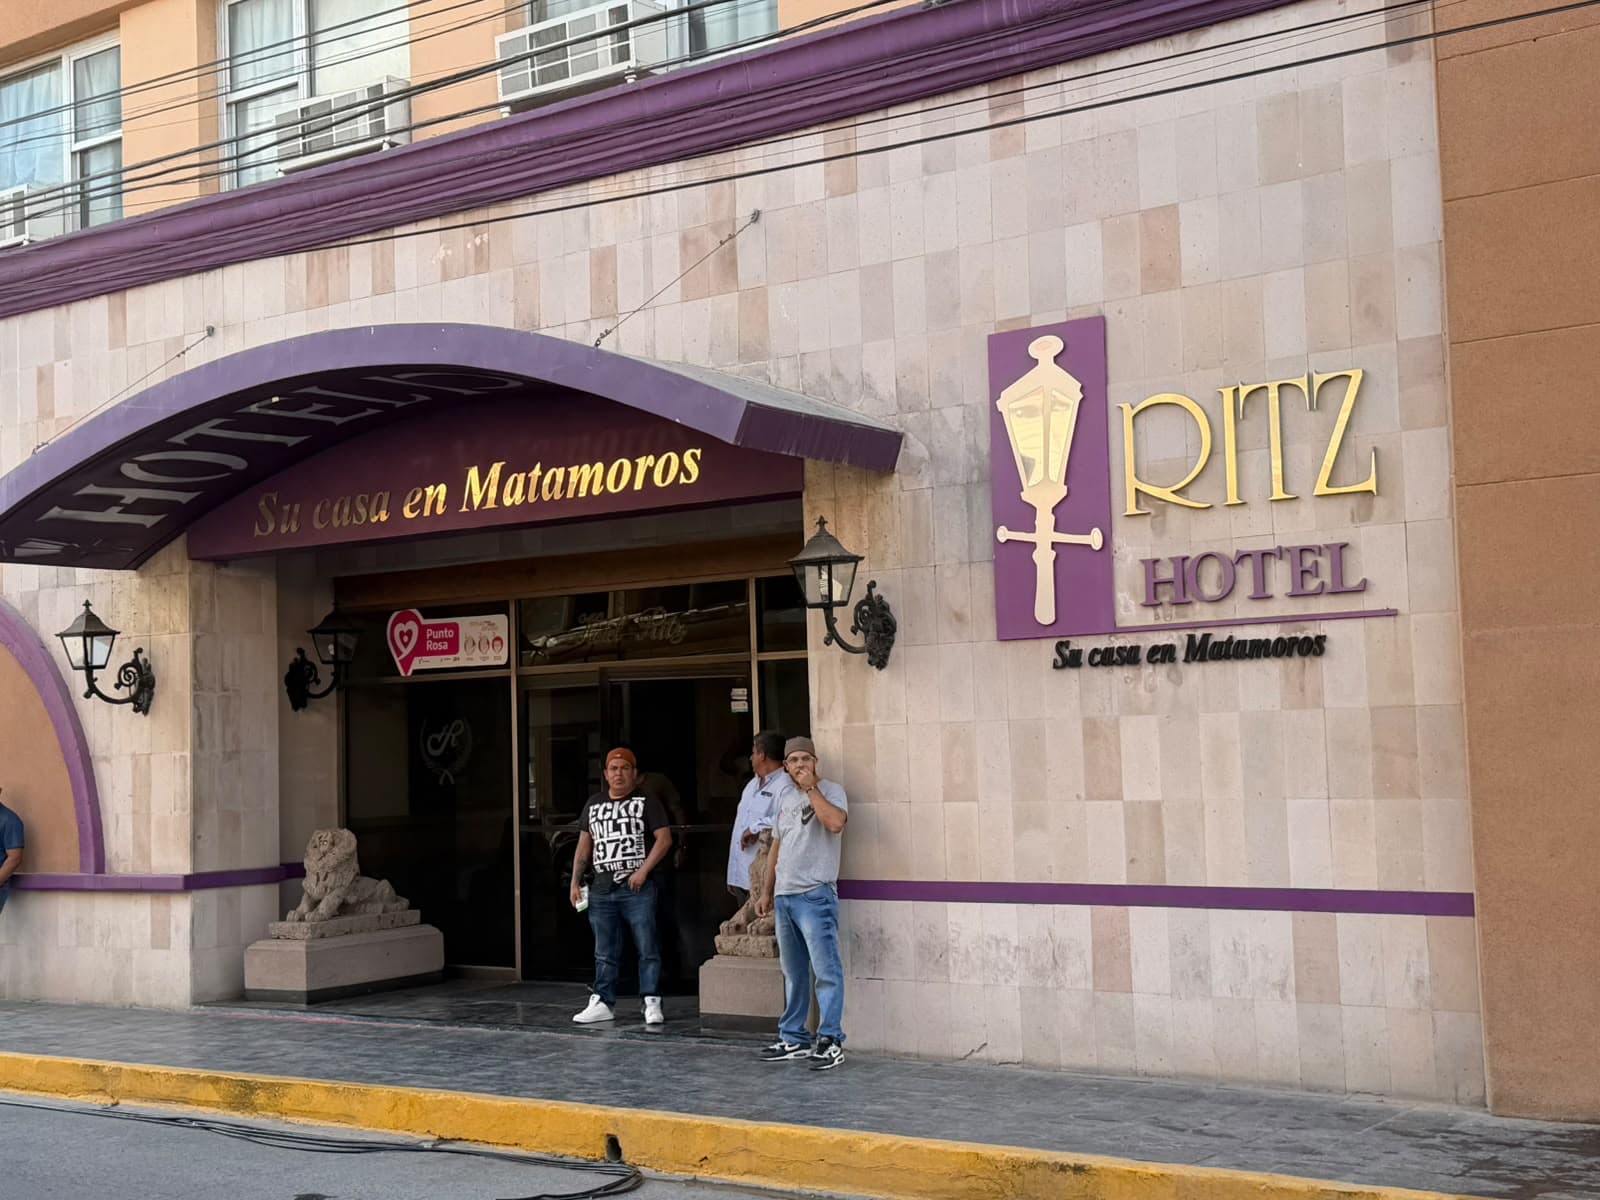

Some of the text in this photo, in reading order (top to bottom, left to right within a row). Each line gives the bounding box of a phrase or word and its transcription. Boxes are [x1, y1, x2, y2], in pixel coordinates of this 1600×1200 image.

[35, 385, 432, 528] HOTEL
[1117, 368, 1377, 516] RITZ
[254, 448, 702, 537] Su casa en Matamoros
[1139, 542, 1367, 608] HOTEL
[426, 628, 454, 640] Punto
[426, 640, 448, 651] Rosa
[1053, 632, 1327, 670] Su casa en Matamoros
[605, 861, 624, 872] THE
